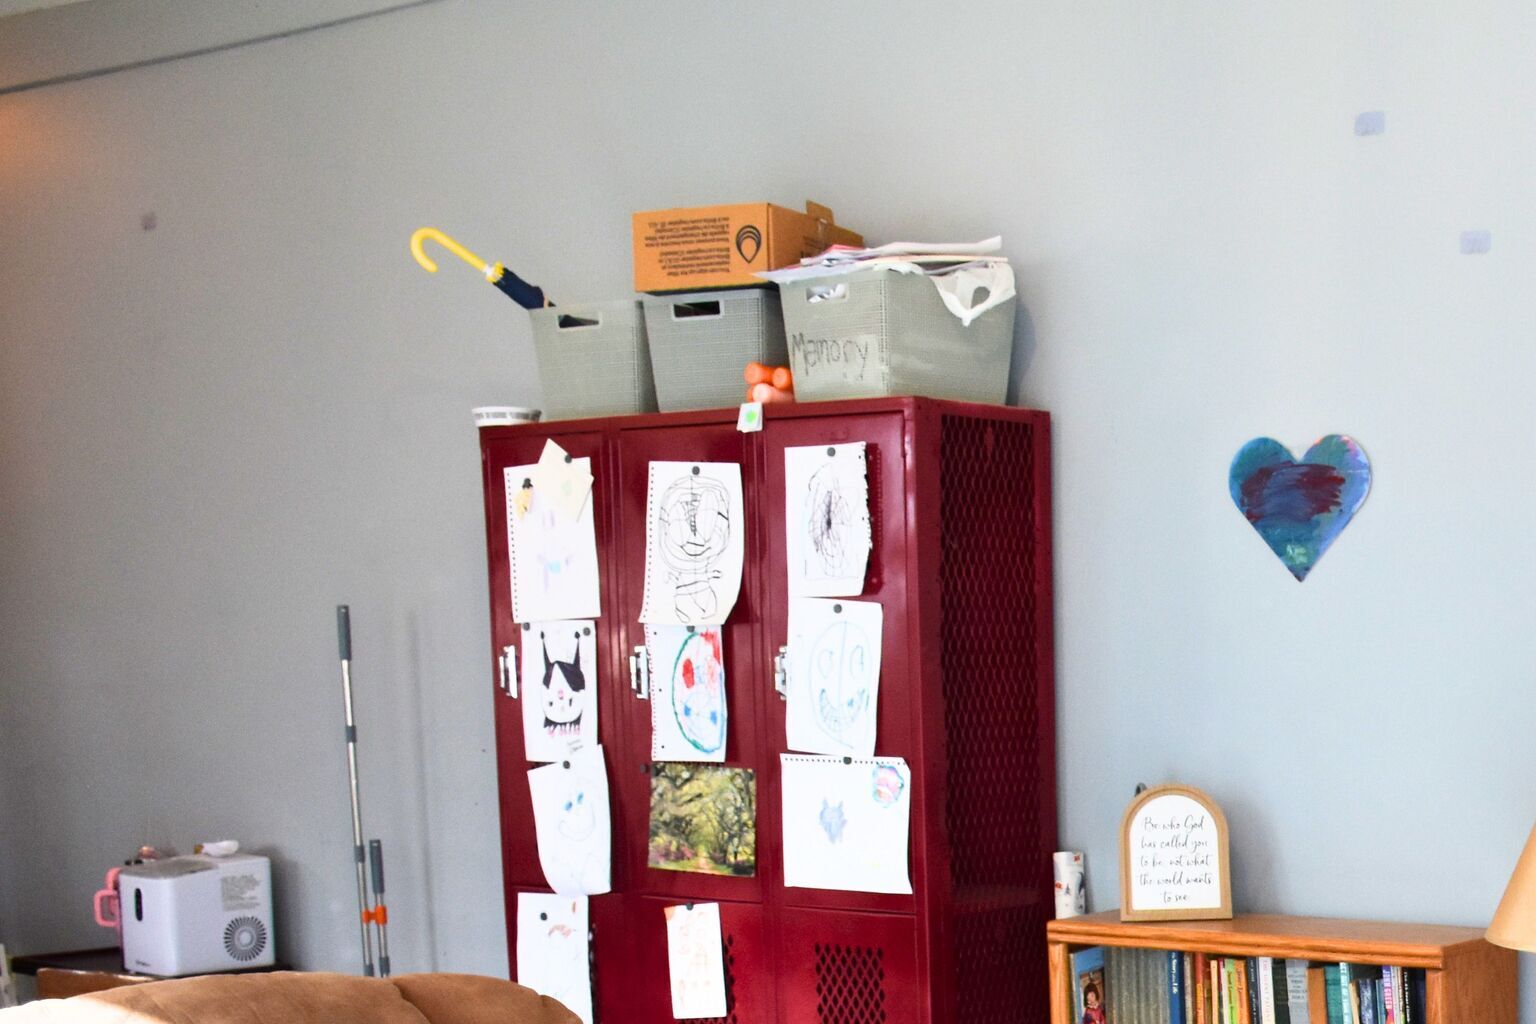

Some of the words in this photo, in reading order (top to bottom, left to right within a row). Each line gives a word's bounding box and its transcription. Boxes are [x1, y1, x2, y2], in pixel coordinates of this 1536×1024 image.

[1162, 817, 1180, 830] who
[1184, 815, 1204, 834] God
[1140, 836, 1157, 849] has
[1160, 834, 1188, 848] called
[1191, 840, 1209, 854] you
[1140, 855, 1149, 867] to
[1169, 854, 1183, 867] not
[1186, 853, 1212, 867] what
[1138, 873, 1153, 886] the
[1157, 871, 1183, 886] world
[1186, 872, 1212, 885] wants
[1163, 890, 1172, 903] to
[1175, 894, 1188, 902] see
[1384, 988, 1393, 1010] GREEN
